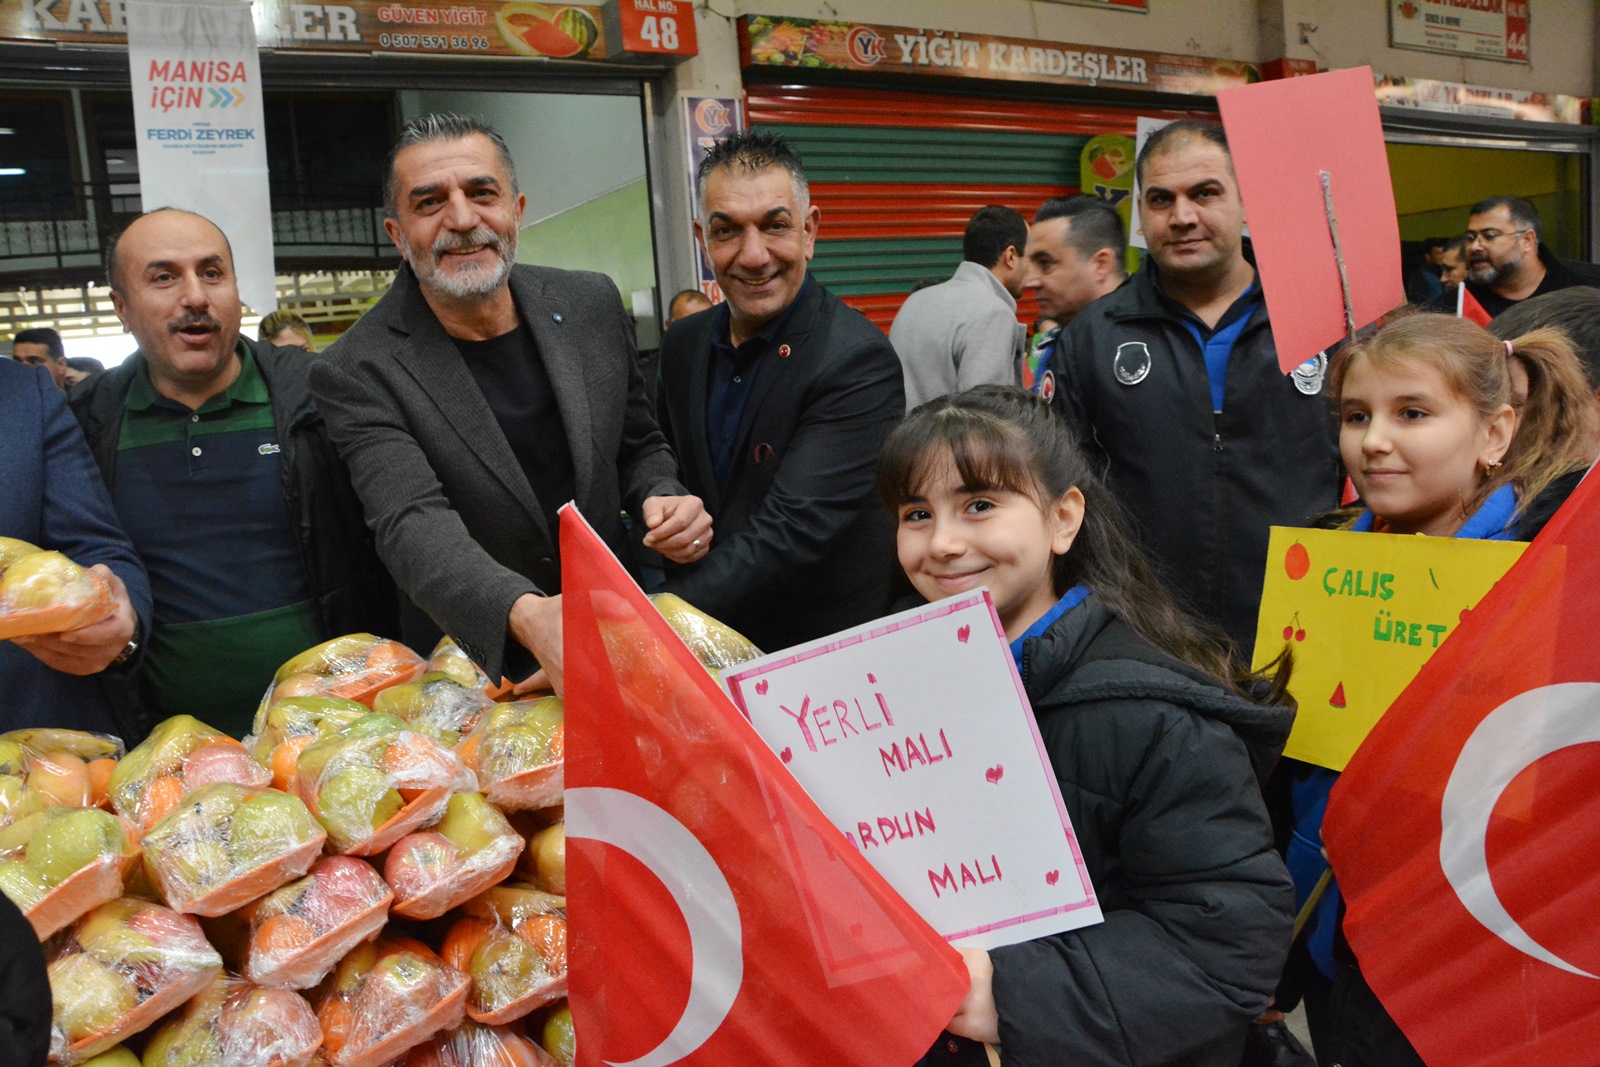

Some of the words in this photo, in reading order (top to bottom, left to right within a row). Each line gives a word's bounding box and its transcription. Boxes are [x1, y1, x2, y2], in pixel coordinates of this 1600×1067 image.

[378, 4, 438, 24] GÜVEN
[440, 6, 486, 25] YİĞİT
[634, 0, 656, 10] HAL
[380, 34, 391, 47] 0
[392, 35, 419, 47] 507
[422, 36, 448, 48] 591
[451, 36, 470, 48] 36
[471, 37, 489, 49] 96
[640, 16, 680, 50] 48
[894, 28, 981, 68] YİĞİT
[986, 42, 1149, 87] KARDEŞLER
[196, 128, 256, 141] ZEYREK
[1323, 567, 1395, 601] ÇALIŞ
[1373, 609, 1448, 648] ÜRET
[779, 673, 895, 752] YERLİ
[878, 728, 953, 778] MALI
[927, 854, 1003, 898] MALI
